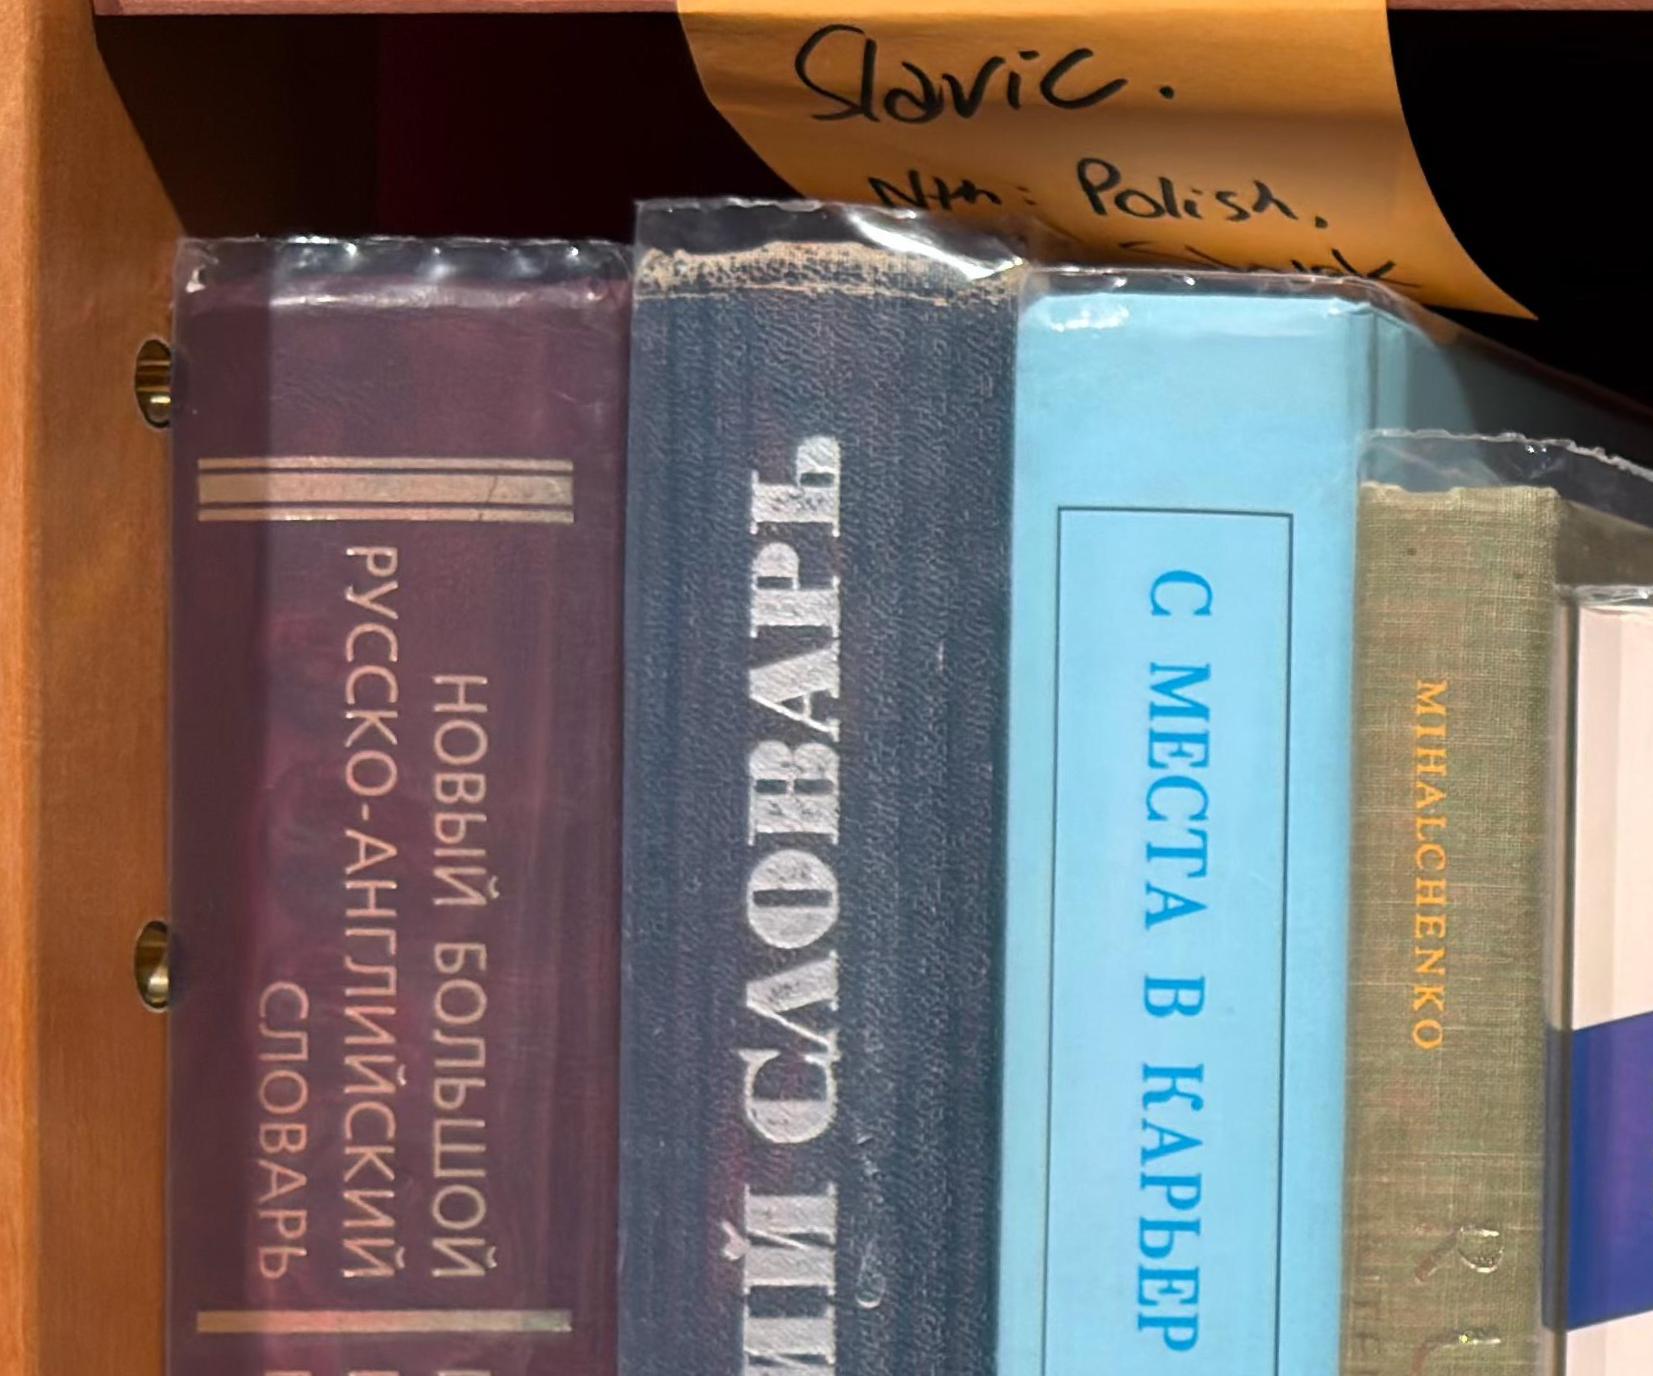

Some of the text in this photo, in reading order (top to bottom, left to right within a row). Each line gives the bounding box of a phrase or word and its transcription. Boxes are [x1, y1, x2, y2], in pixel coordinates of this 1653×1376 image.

[341, 541, 405, 1283] РУССКО-АНГЛИЙСКИЙ
[741, 434, 842, 1146] СЛОВАРЬ
[1140, 661, 1212, 935] МЕСТА
[1411, 677, 1450, 1052] MIHALCHENKO
[256, 982, 311, 1283] СЛОВАРЬ
[431, 671, 499, 1281] НОВЫЙ БОЛЬШОЙ
[1140, 972, 1208, 1021] В
[1132, 1062, 1206, 1357] КАРЬЕР
